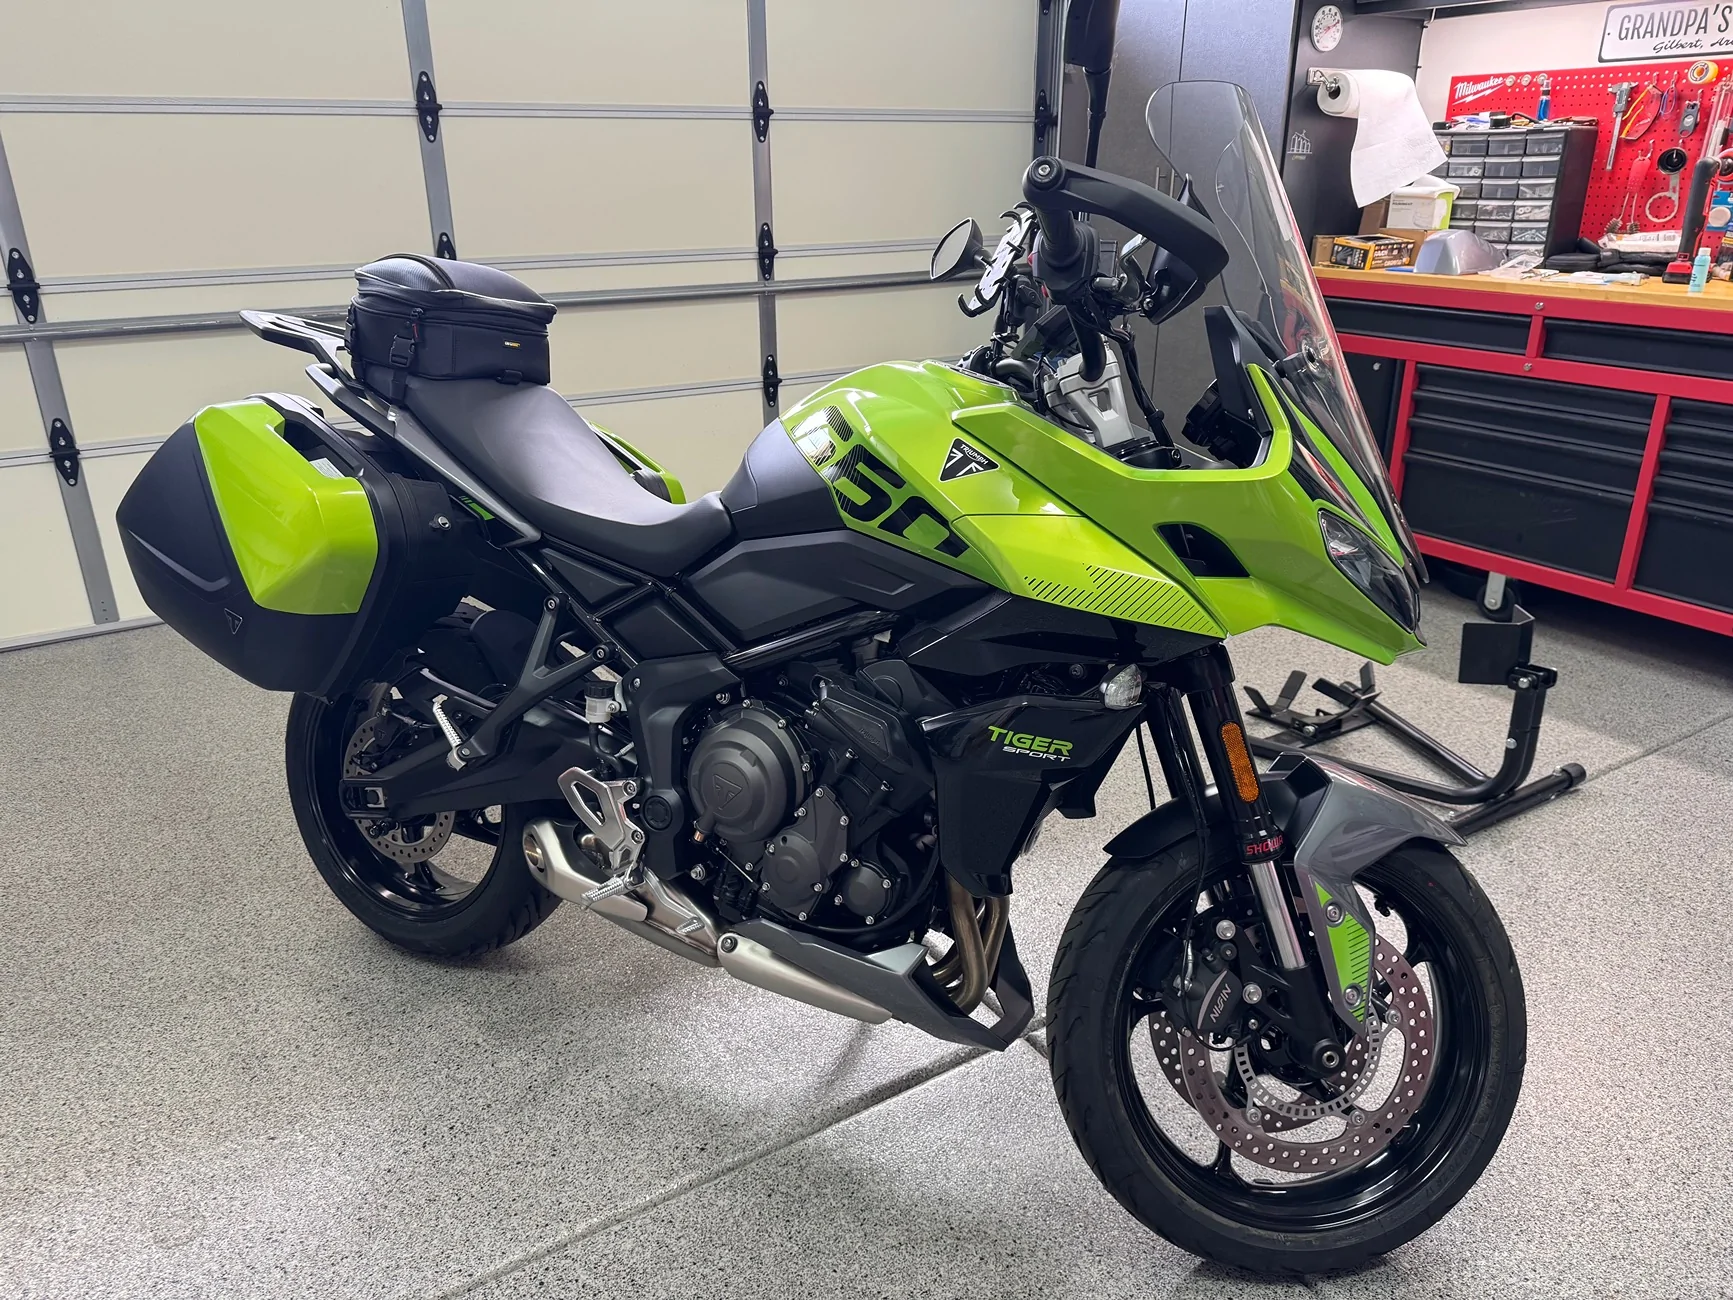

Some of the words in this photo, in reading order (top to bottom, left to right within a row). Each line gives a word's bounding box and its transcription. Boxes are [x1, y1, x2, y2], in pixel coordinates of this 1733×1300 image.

[1618, 3, 1733, 41] GRANDPA'S
[1652, 38, 1704, 54] Gilbert,
[1453, 76, 1505, 99] Milwaukee
[960, 443, 989, 465] TRIUMPH
[988, 725, 1073, 756] TIGER
[1002, 745, 1071, 762] SPORT
